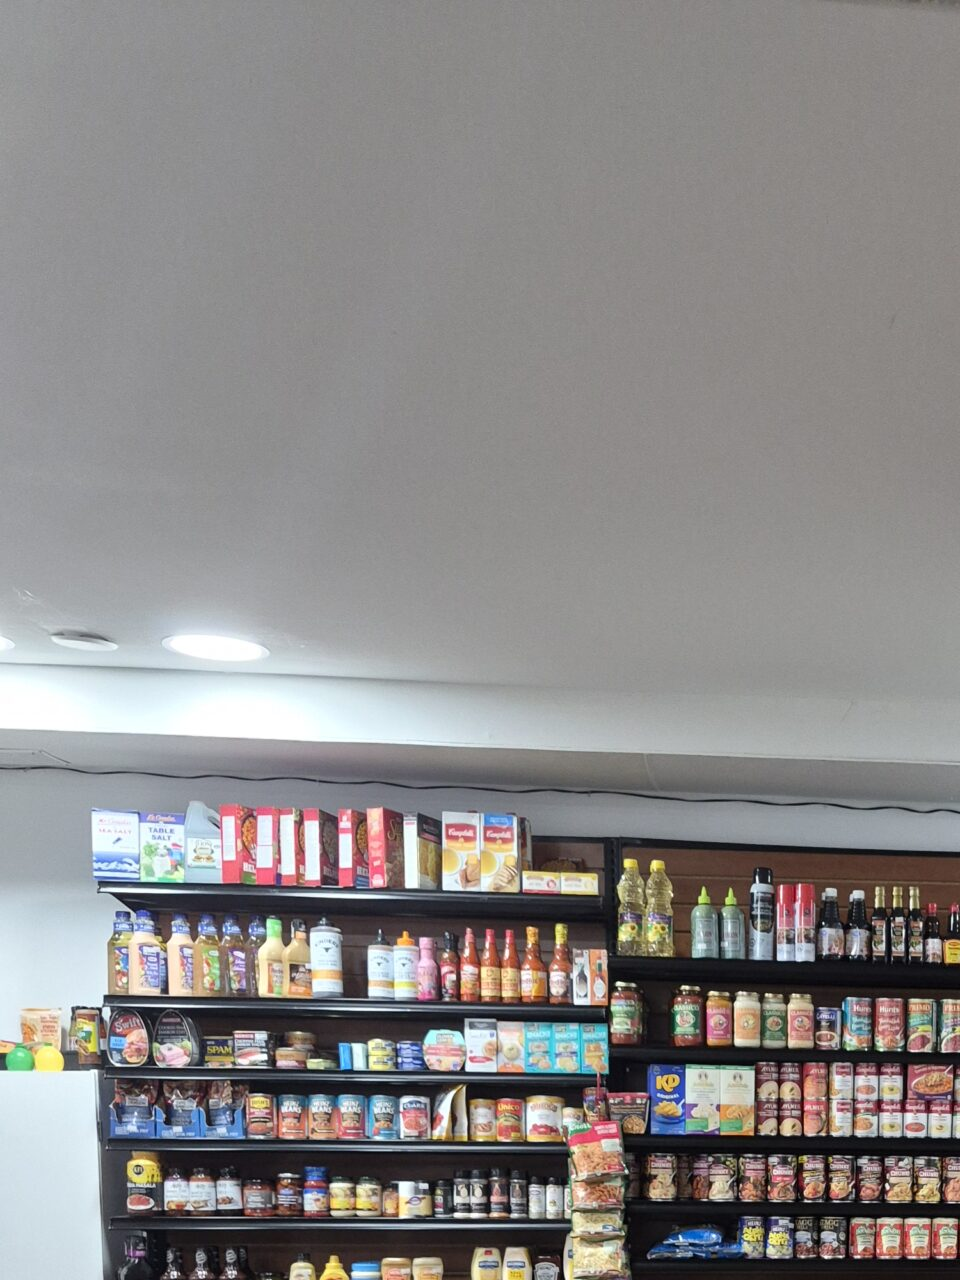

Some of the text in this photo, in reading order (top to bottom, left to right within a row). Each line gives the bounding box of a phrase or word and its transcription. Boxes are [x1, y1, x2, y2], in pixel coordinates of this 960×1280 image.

[148, 827, 175, 835] TABLE
[151, 834, 171, 842] SALT
[908, 1004, 931, 1012] PRIMO
[114, 1018, 141, 1031] Swift
[207, 1045, 232, 1055] SPAM
[656, 1074, 681, 1092] KD
